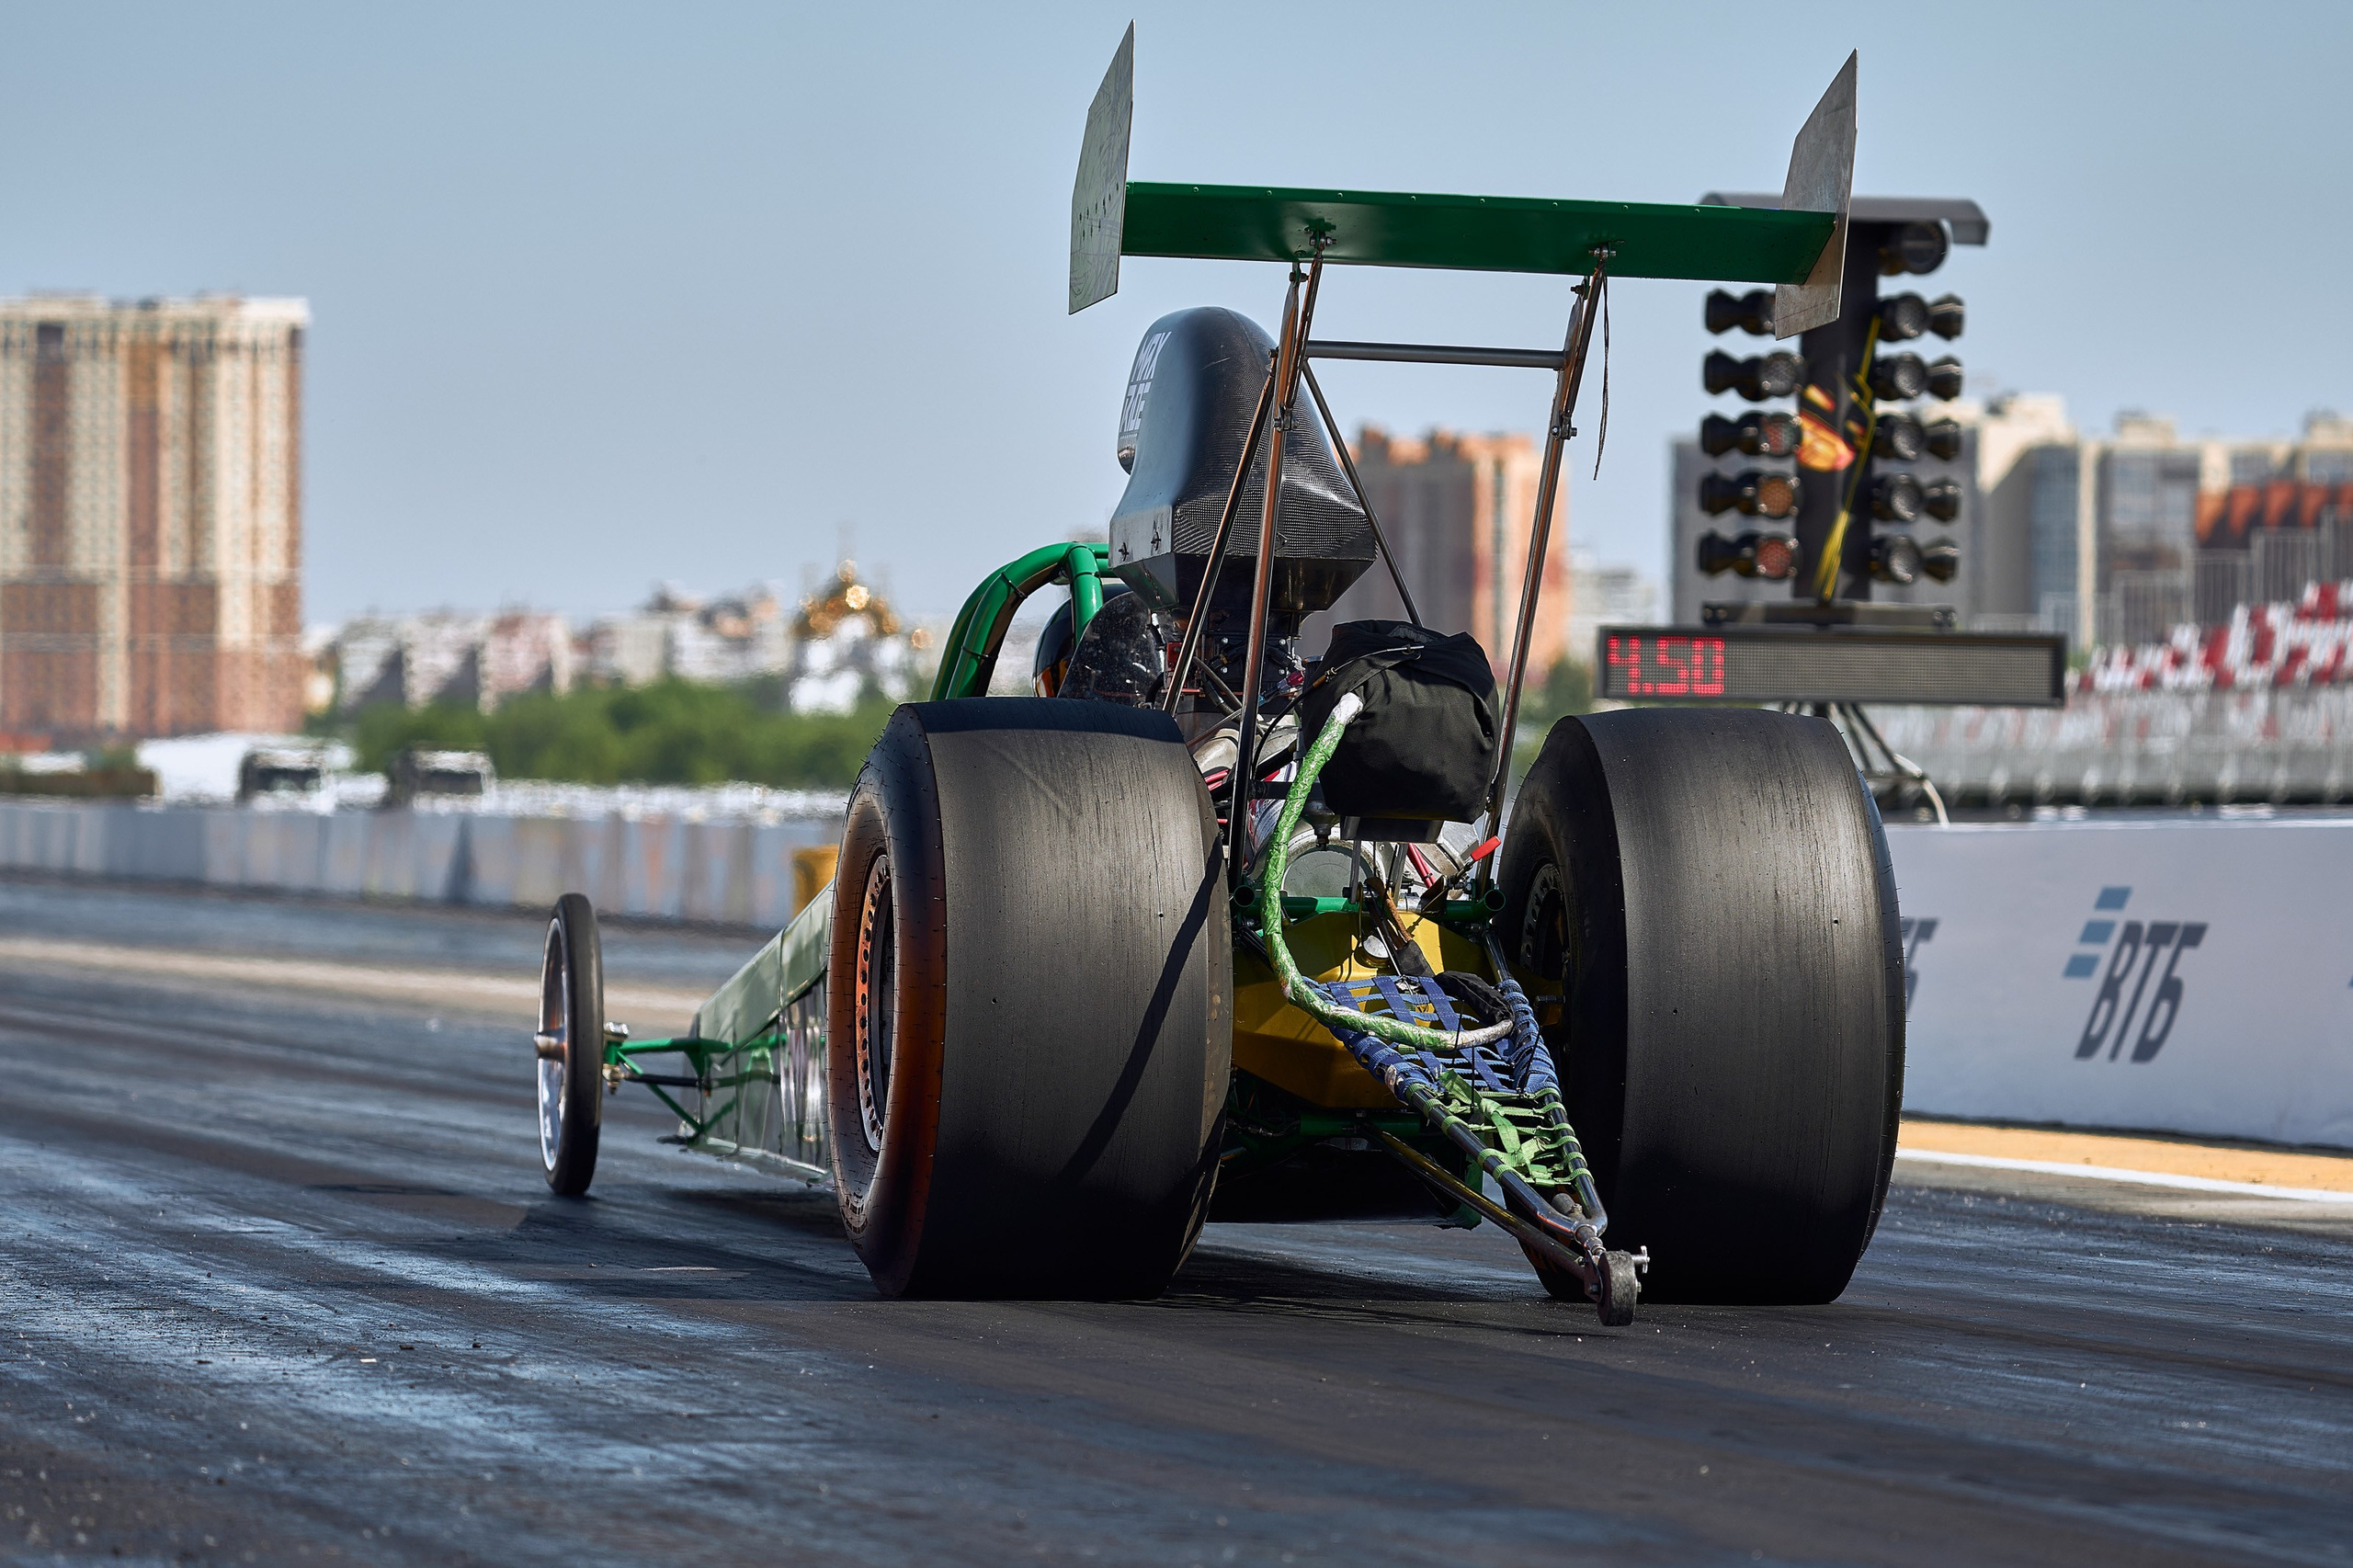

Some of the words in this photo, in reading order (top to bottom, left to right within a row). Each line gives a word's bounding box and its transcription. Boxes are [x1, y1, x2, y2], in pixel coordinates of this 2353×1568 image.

[1131, 332, 1172, 381] MAX
[1608, 636, 1724, 694] 4.50
[2075, 920, 2208, 1063] ВТБ
